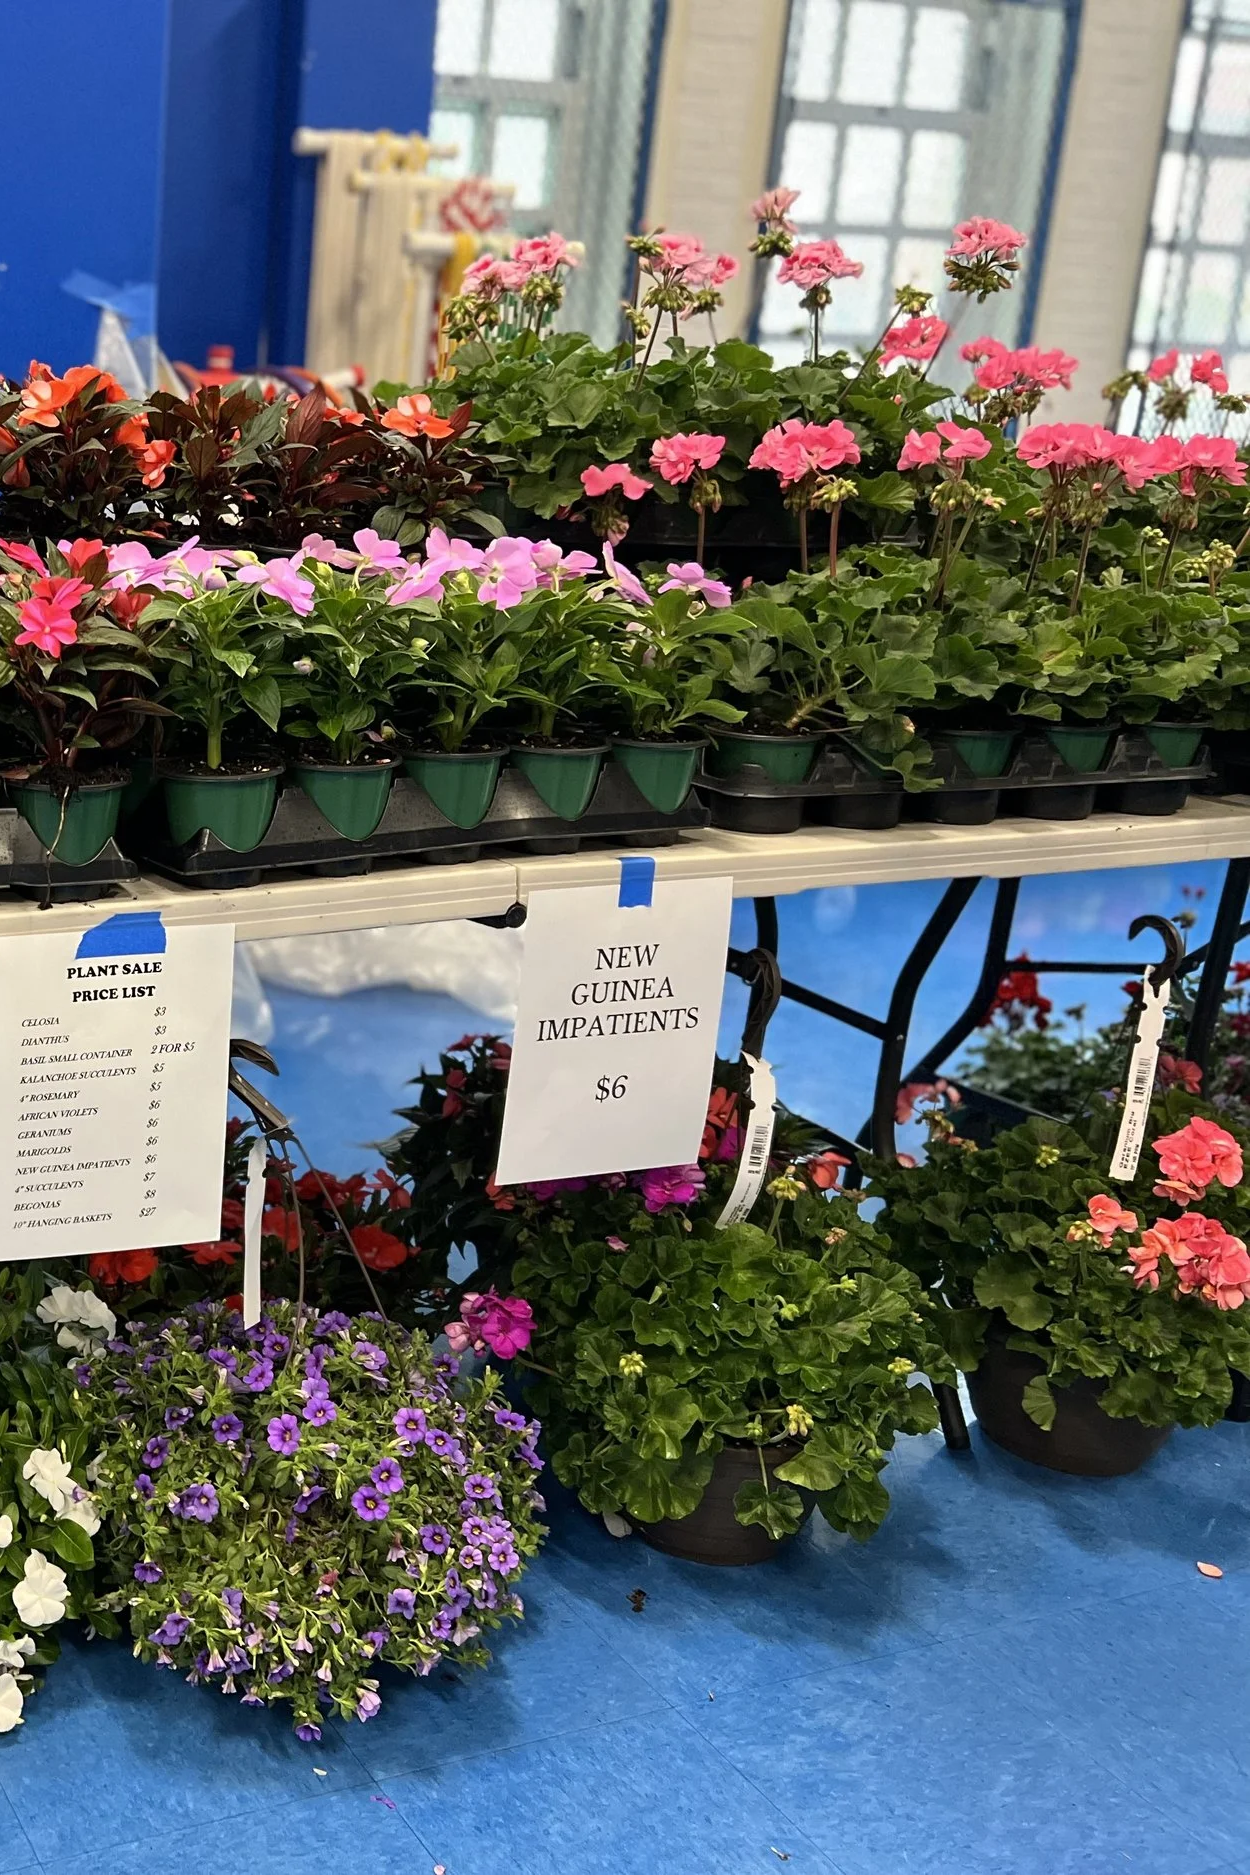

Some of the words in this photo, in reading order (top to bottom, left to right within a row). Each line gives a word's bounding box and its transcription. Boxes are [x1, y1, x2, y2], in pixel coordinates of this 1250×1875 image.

[594, 943, 660, 970] NEW
[67, 964, 119, 979] PLANT
[122, 961, 163, 975] SALE
[72, 988, 119, 1002] PRICE
[122, 985, 156, 999] LIST
[571, 976, 674, 1006] GUINEA
[21, 1017, 60, 1028] CELOSIA
[154, 1006, 167, 1017] $3
[536, 1007, 699, 1042] IMPATIENTS
[21, 1035, 70, 1047] DIANTHUS
[154, 1025, 167, 1036] $3
[20, 1056, 47, 1066] BASIL
[48, 1053, 79, 1063] SMALL
[79, 1049, 133, 1061] CONTAINER
[150, 1045, 158, 1055] 2
[158, 1042, 181, 1054] FOR
[183, 1041, 196, 1052] $5
[19, 1071, 78, 1085] KALANCHOE
[78, 1067, 137, 1080] SUCCULENTS
[152, 1063, 165, 1073] $5
[19, 1094, 29, 1103] 4"
[29, 1090, 80, 1102] ROSEMARY
[149, 1081, 162, 1092] $5
[595, 1074, 628, 1103] $6
[18, 1110, 59, 1122] AFRICAN
[60, 1107, 99, 1118] VIOLETS
[148, 1099, 161, 1110] $6
[17, 1128, 73, 1140] GERANIUMS
[146, 1118, 159, 1129] $6
[16, 1146, 72, 1158] MARIGOLDS
[146, 1135, 159, 1146] $6
[15, 1167, 39, 1176] NEW
[40, 1163, 75, 1174] GUINEA
[76, 1158, 131, 1171] IMPATIENTS
[145, 1154, 157, 1165] $6
[15, 1185, 24, 1194] 4"
[24, 1180, 84, 1193] SUCCULENTS
[143, 1172, 156, 1182] $7
[14, 1200, 62, 1212] BEGONIAS
[144, 1189, 157, 1200] $8
[13, 1220, 27, 1230] 10"
[27, 1216, 72, 1228] HANGING
[73, 1213, 112, 1225] BASKETS
[139, 1207, 156, 1218] $27
